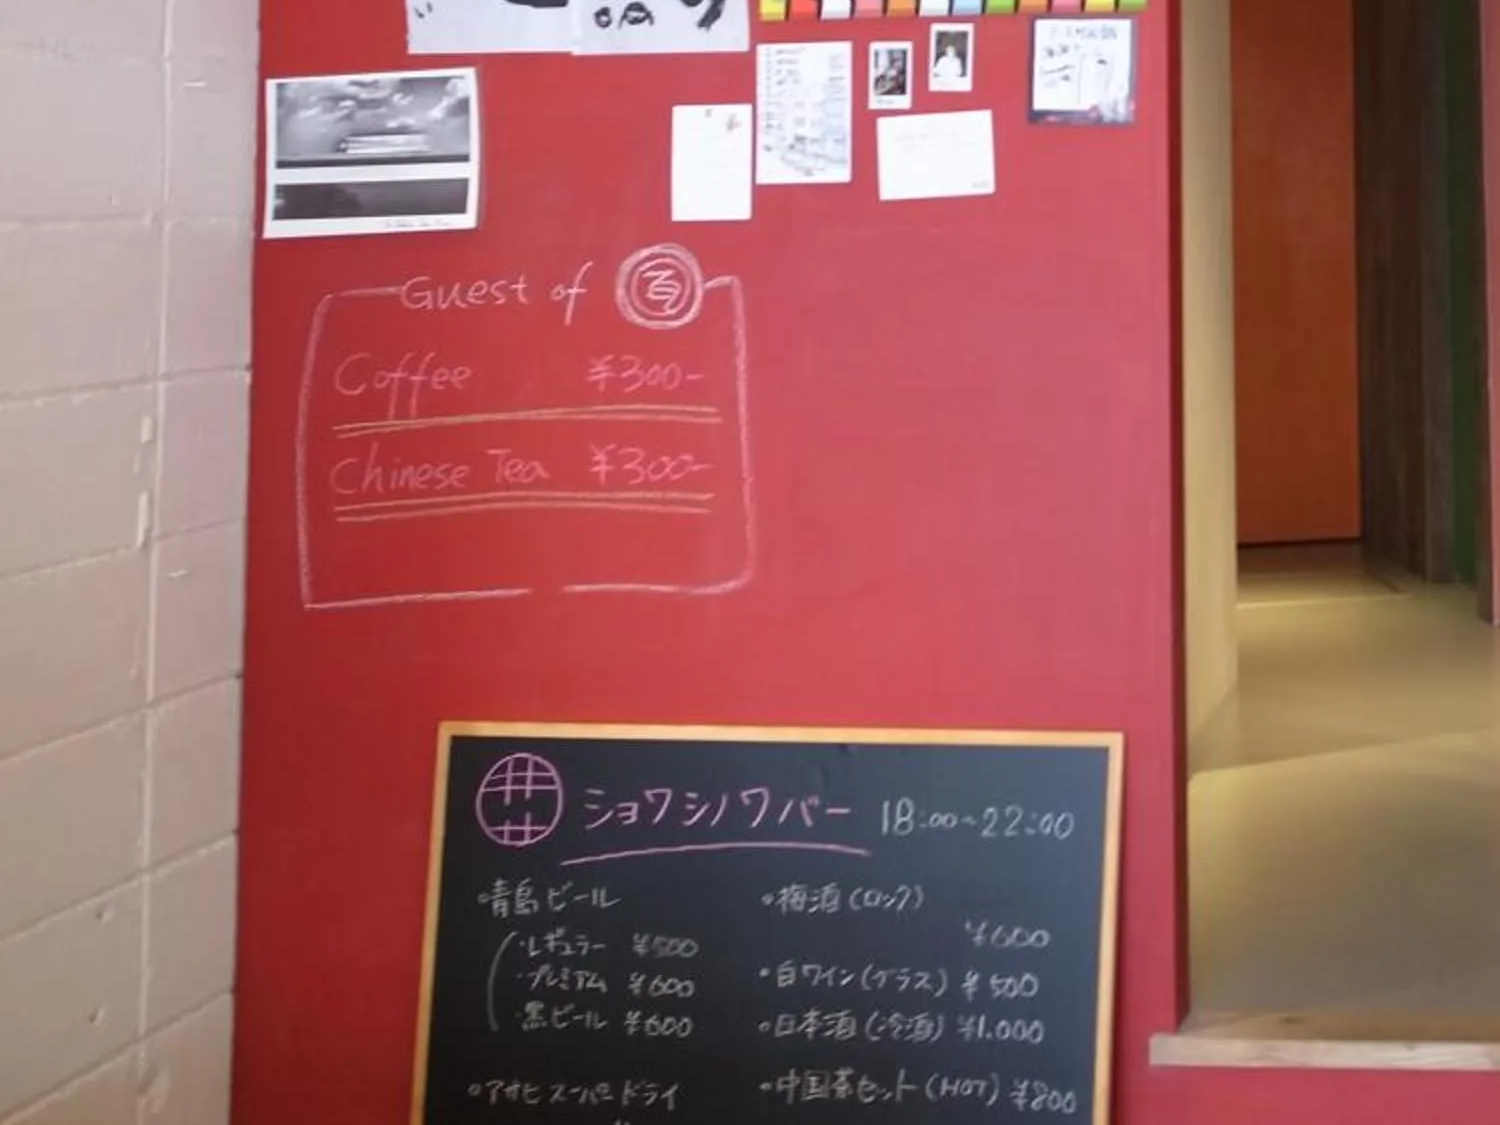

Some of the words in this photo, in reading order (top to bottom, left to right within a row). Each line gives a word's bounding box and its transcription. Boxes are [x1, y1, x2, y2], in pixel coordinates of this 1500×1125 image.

[401, 274, 530, 311] Guest
[550, 261, 593, 326] of
[334, 352, 472, 421] Coffee
[329, 442, 470, 494] Chinese
[483, 447, 550, 482] Tea
